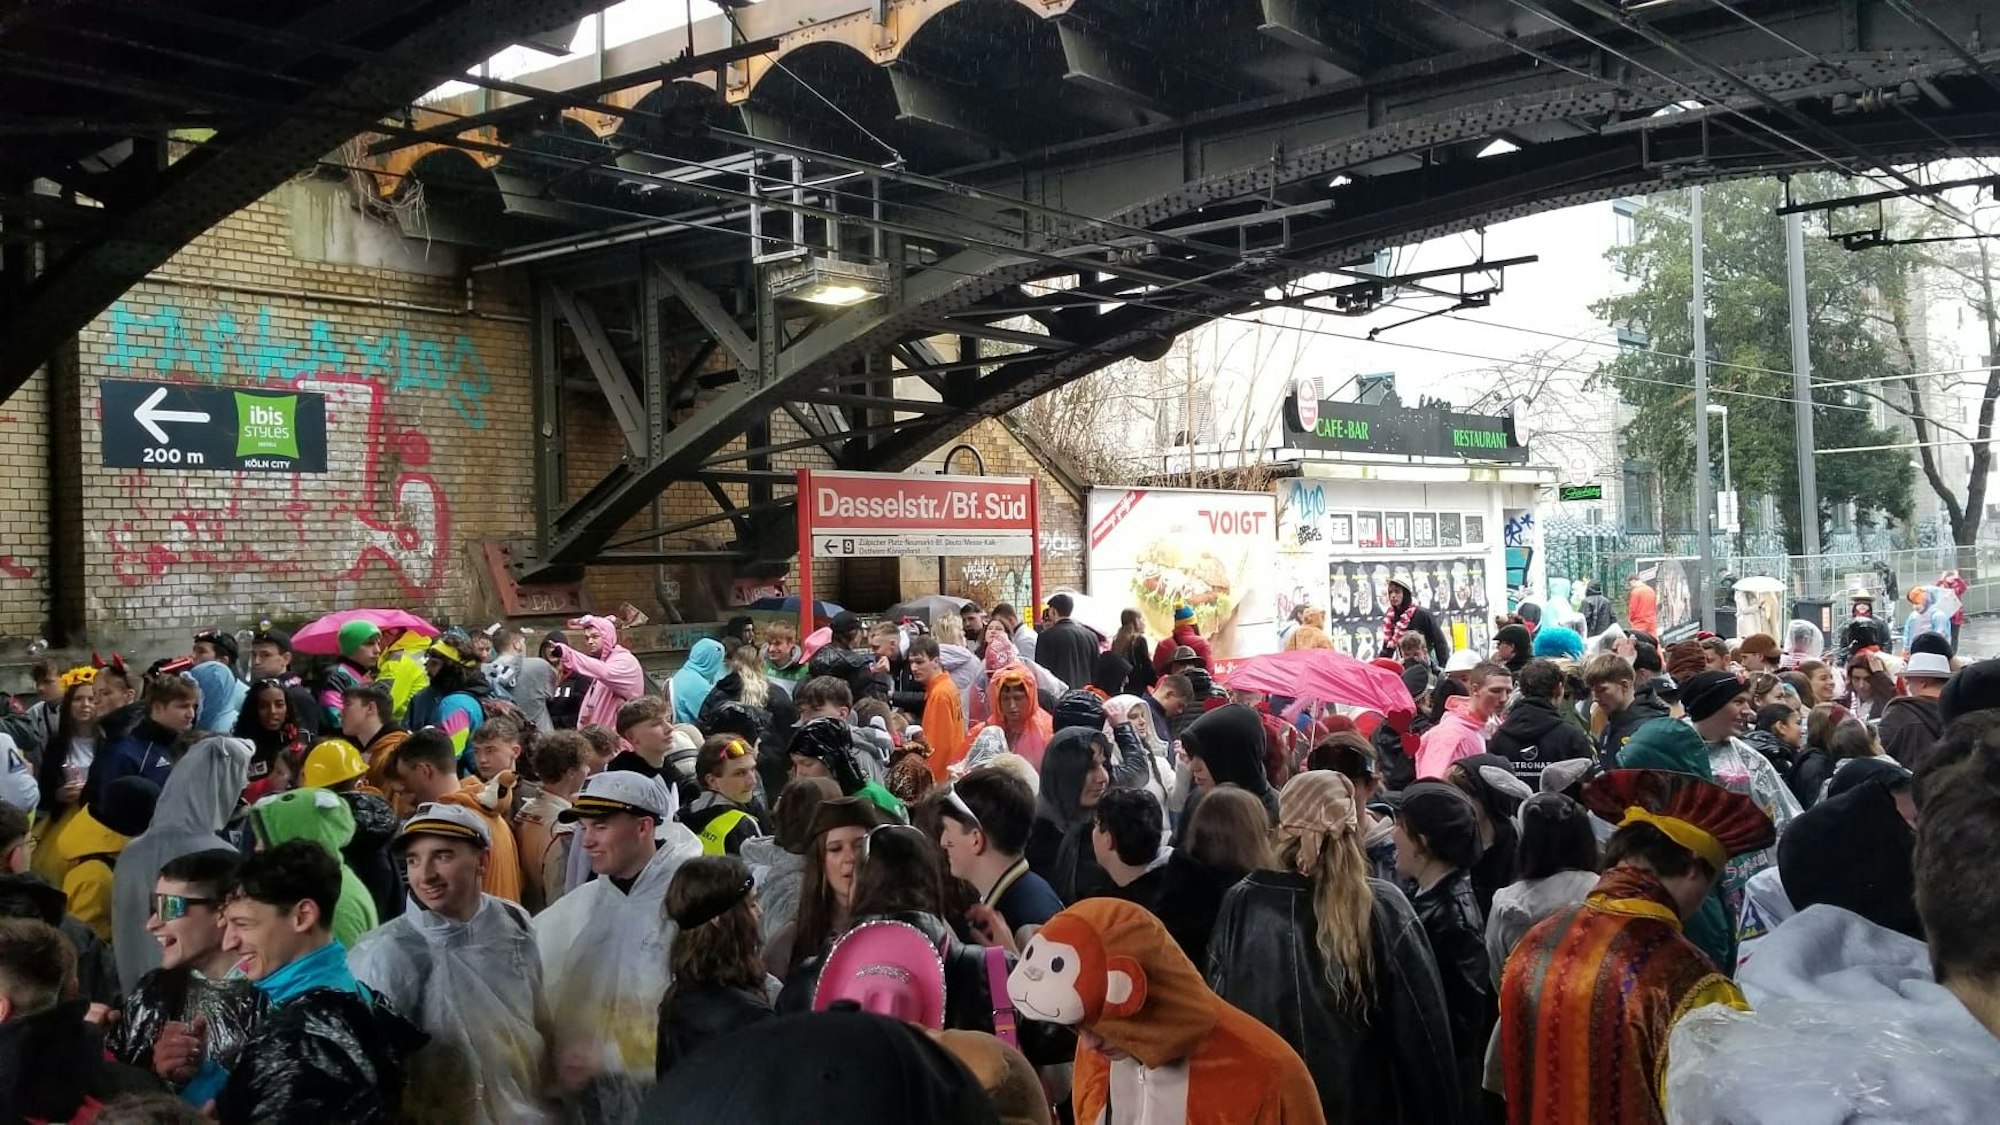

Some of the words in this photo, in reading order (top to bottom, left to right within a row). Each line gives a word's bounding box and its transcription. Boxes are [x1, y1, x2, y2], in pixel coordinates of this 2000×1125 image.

[250, 405, 284, 426] ibis
[1453, 429, 1507, 449] RESTAURANT
[143, 448, 181, 463] 200
[187, 451, 204, 464] m
[244, 458, 270, 469] KÖLN
[270, 460, 291, 470] CITY
[984, 493, 1026, 520] Süd
[1198, 510, 1267, 535] VOIGT
[845, 540, 853, 553] 9
